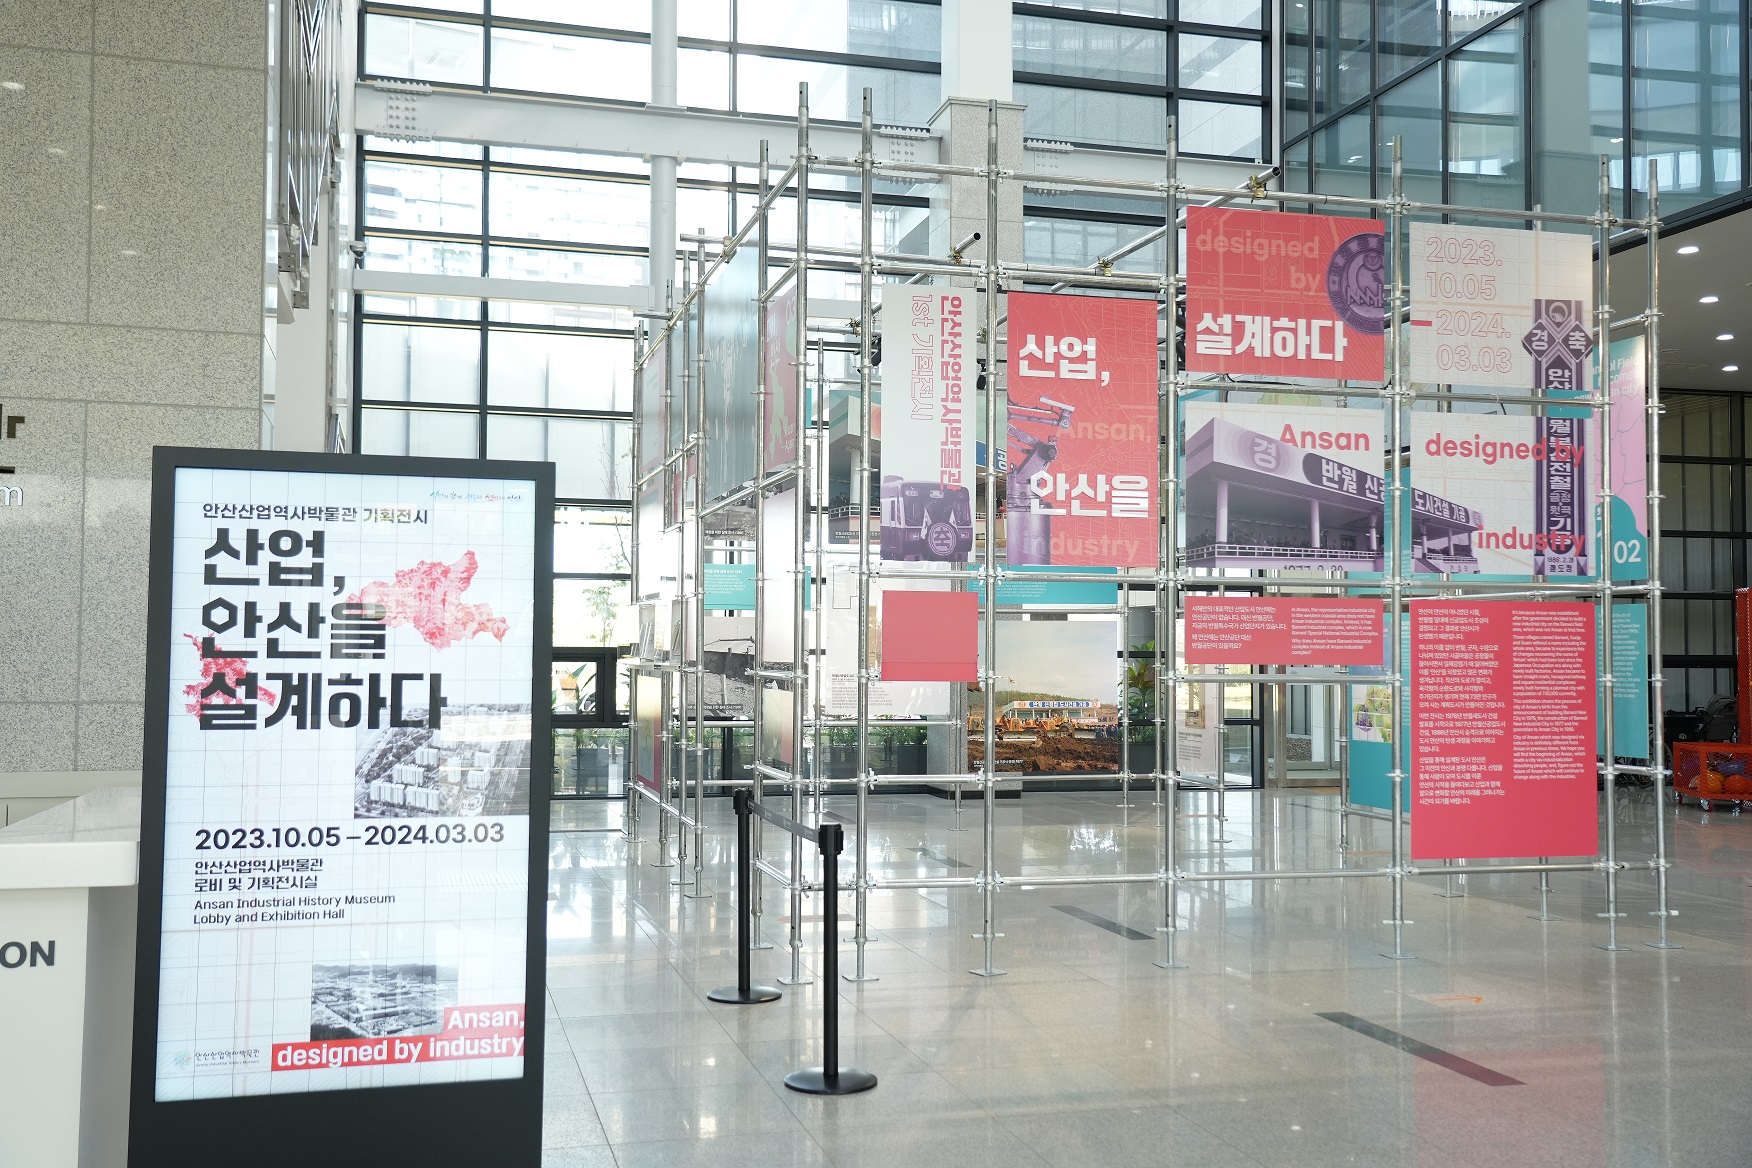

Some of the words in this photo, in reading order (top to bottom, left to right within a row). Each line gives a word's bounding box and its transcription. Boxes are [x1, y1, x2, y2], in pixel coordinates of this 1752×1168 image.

[1196, 229, 1319, 261] designed
[1426, 236, 1502, 266] 2023.
[1290, 266, 1320, 295] by
[1427, 272, 1496, 301] 10.05
[911, 294, 935, 327] 1st
[1436, 310, 1511, 339] 2024.
[1196, 313, 1348, 362] 설계하다
[1532, 329, 1549, 351] 경
[1568, 331, 1587, 353] 축
[1020, 334, 1110, 387] 산업,
[1437, 345, 1512, 373] 03.03
[911, 333, 934, 421] 기획전시
[940, 295, 962, 492] 안산산업역사박물관
[1056, 420, 1151, 444] Ansan,
[1280, 424, 1370, 451] Ansan
[1253, 437, 1277, 469] 경
[1425, 433, 1549, 466] designed
[1554, 437, 1585, 468] by
[1321, 458, 1358, 495] 반월
[1030, 471, 1148, 518] 안산을
[1414, 490, 1450, 520] 도시건설
[1452, 503, 1467, 523] 기공
[203, 503, 357, 522] 안산산업역사박물관
[364, 508, 428, 524] 기획전시
[1023, 534, 1139, 565] industry
[1477, 525, 1585, 559] industry
[1613, 538, 1641, 564] 02
[205, 528, 344, 597] 산업,
[202, 597, 386, 660] 안산을
[200, 673, 447, 731] 설계하다
[195, 826, 340, 850] 2023.10.05
[194, 857, 323, 875] 안산산업역사박물관
[194, 876, 223, 892] 로비
[228, 875, 241, 892] 및
[247, 875, 318, 890] 기획전시실
[194, 898, 232, 910] Ansan
[237, 896, 295, 908] Industrial
[299, 895, 341, 909] History
[345, 893, 396, 905] Museum
[193, 913, 231, 927] Lobby
[235, 912, 257, 923] and
[261, 909, 319, 922] Exhibition
[322, 908, 345, 920] Hall
[447, 1008, 524, 1031] Ansan,
[278, 1041, 388, 1068] designed
[394, 1039, 424, 1064] by
[429, 1034, 524, 1060] industry
